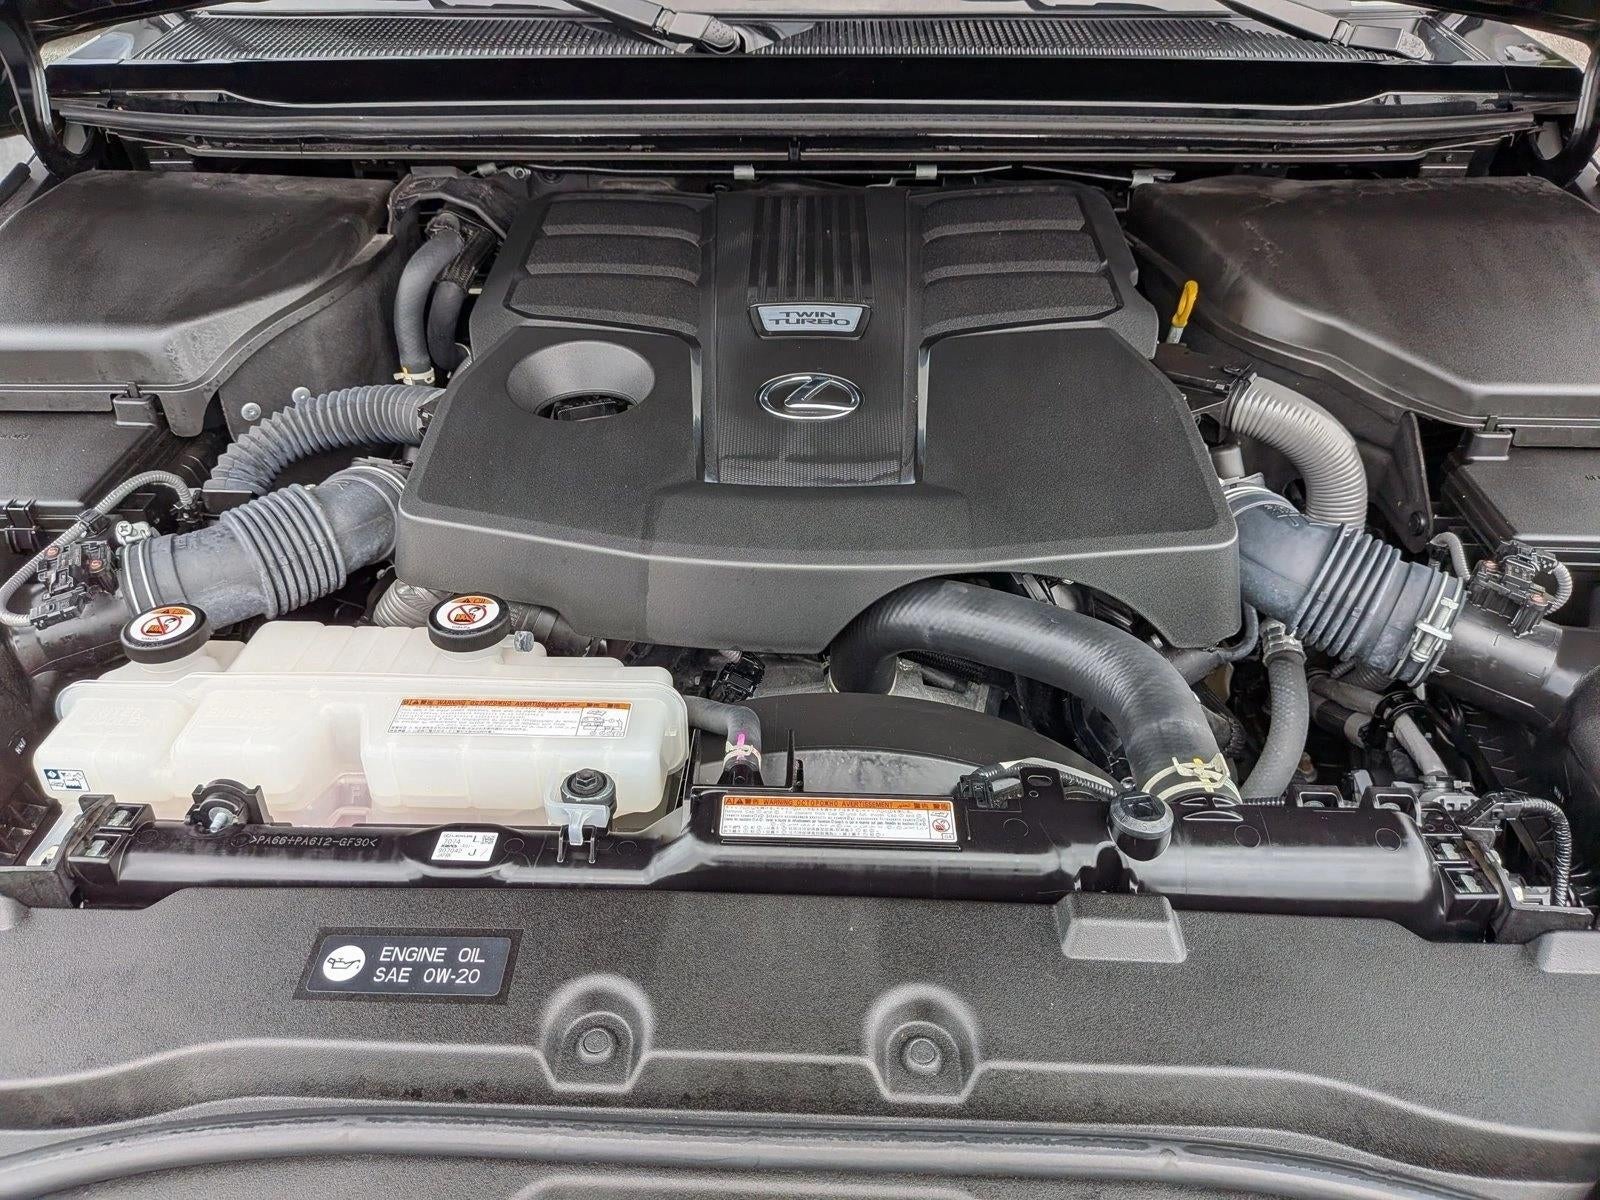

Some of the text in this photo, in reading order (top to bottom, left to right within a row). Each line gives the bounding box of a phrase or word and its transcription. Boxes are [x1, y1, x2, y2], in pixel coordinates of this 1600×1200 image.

[768, 318, 851, 326] TURBO
[763, 798, 794, 806] WARNING
[841, 800, 893, 809] AVERTISSEMENT
[379, 946, 486, 964] ENGINE OIL
[373, 967, 482, 985] SAE 0W-20
